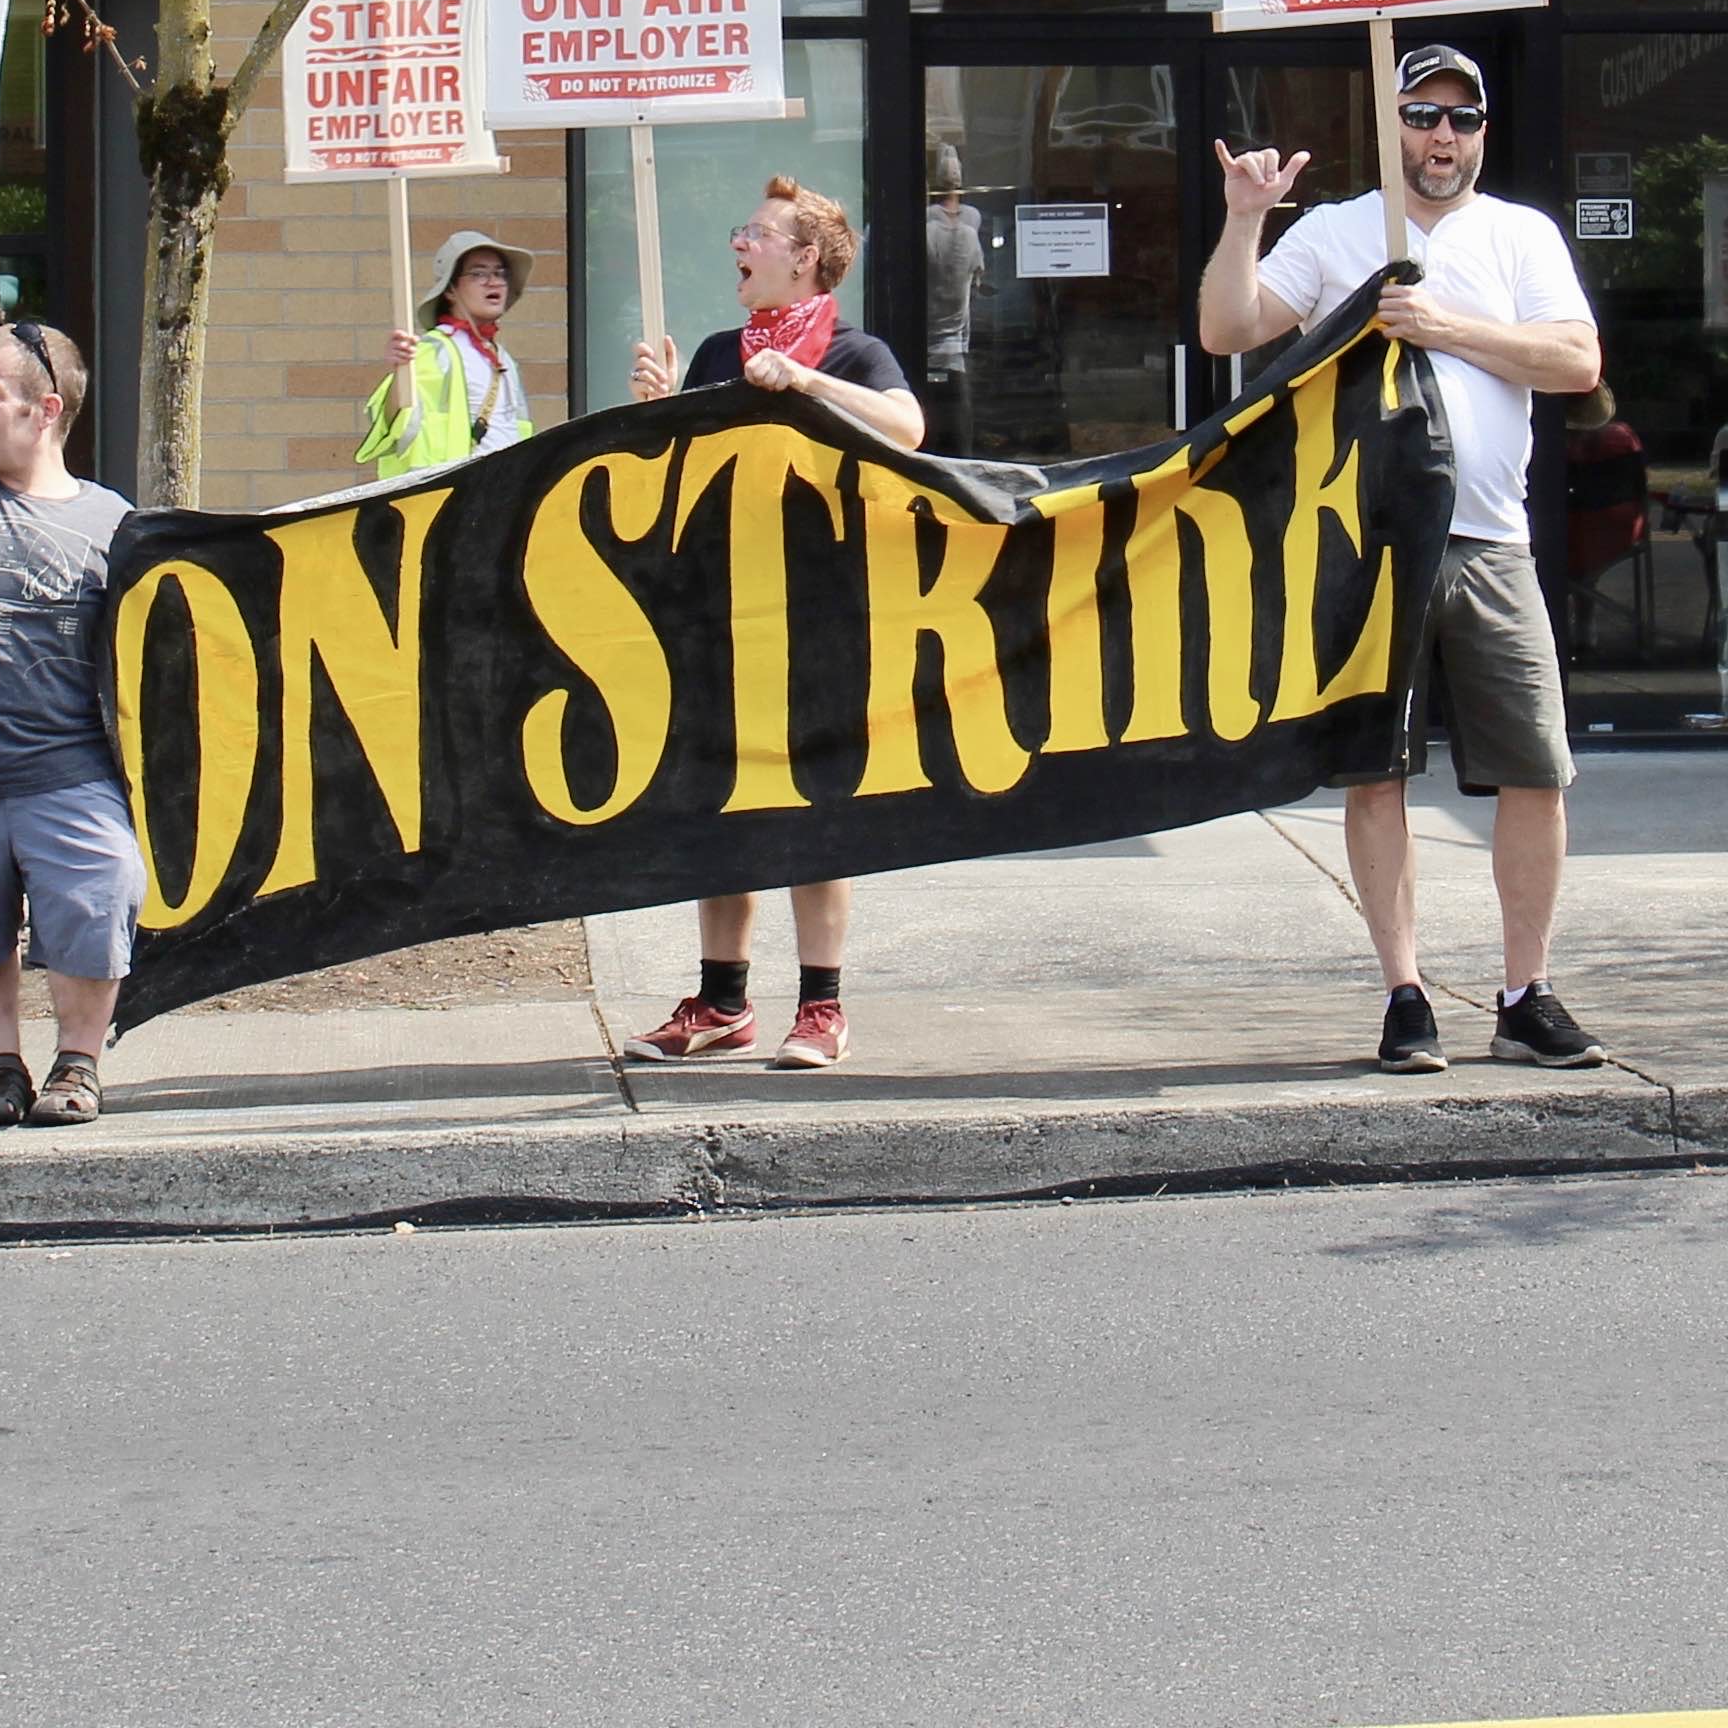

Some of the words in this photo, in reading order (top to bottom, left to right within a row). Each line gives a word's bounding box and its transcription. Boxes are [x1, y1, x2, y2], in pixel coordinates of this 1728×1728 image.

[310, 0, 461, 42] STRIKE
[523, 23, 748, 64] EMPLOYER
[308, 66, 460, 108] UNFAIR
[561, 77, 585, 93] DO
[589, 76, 623, 92] NOT
[627, 72, 716, 90] PATRONIZE
[308, 111, 464, 142] EMPLOYER
[336, 151, 351, 165] DO
[355, 150, 378, 164] NOT
[381, 147, 442, 163] PATRONIZE
[115, 488, 455, 931] ON
[521, 317, 1399, 825] STRIKE
